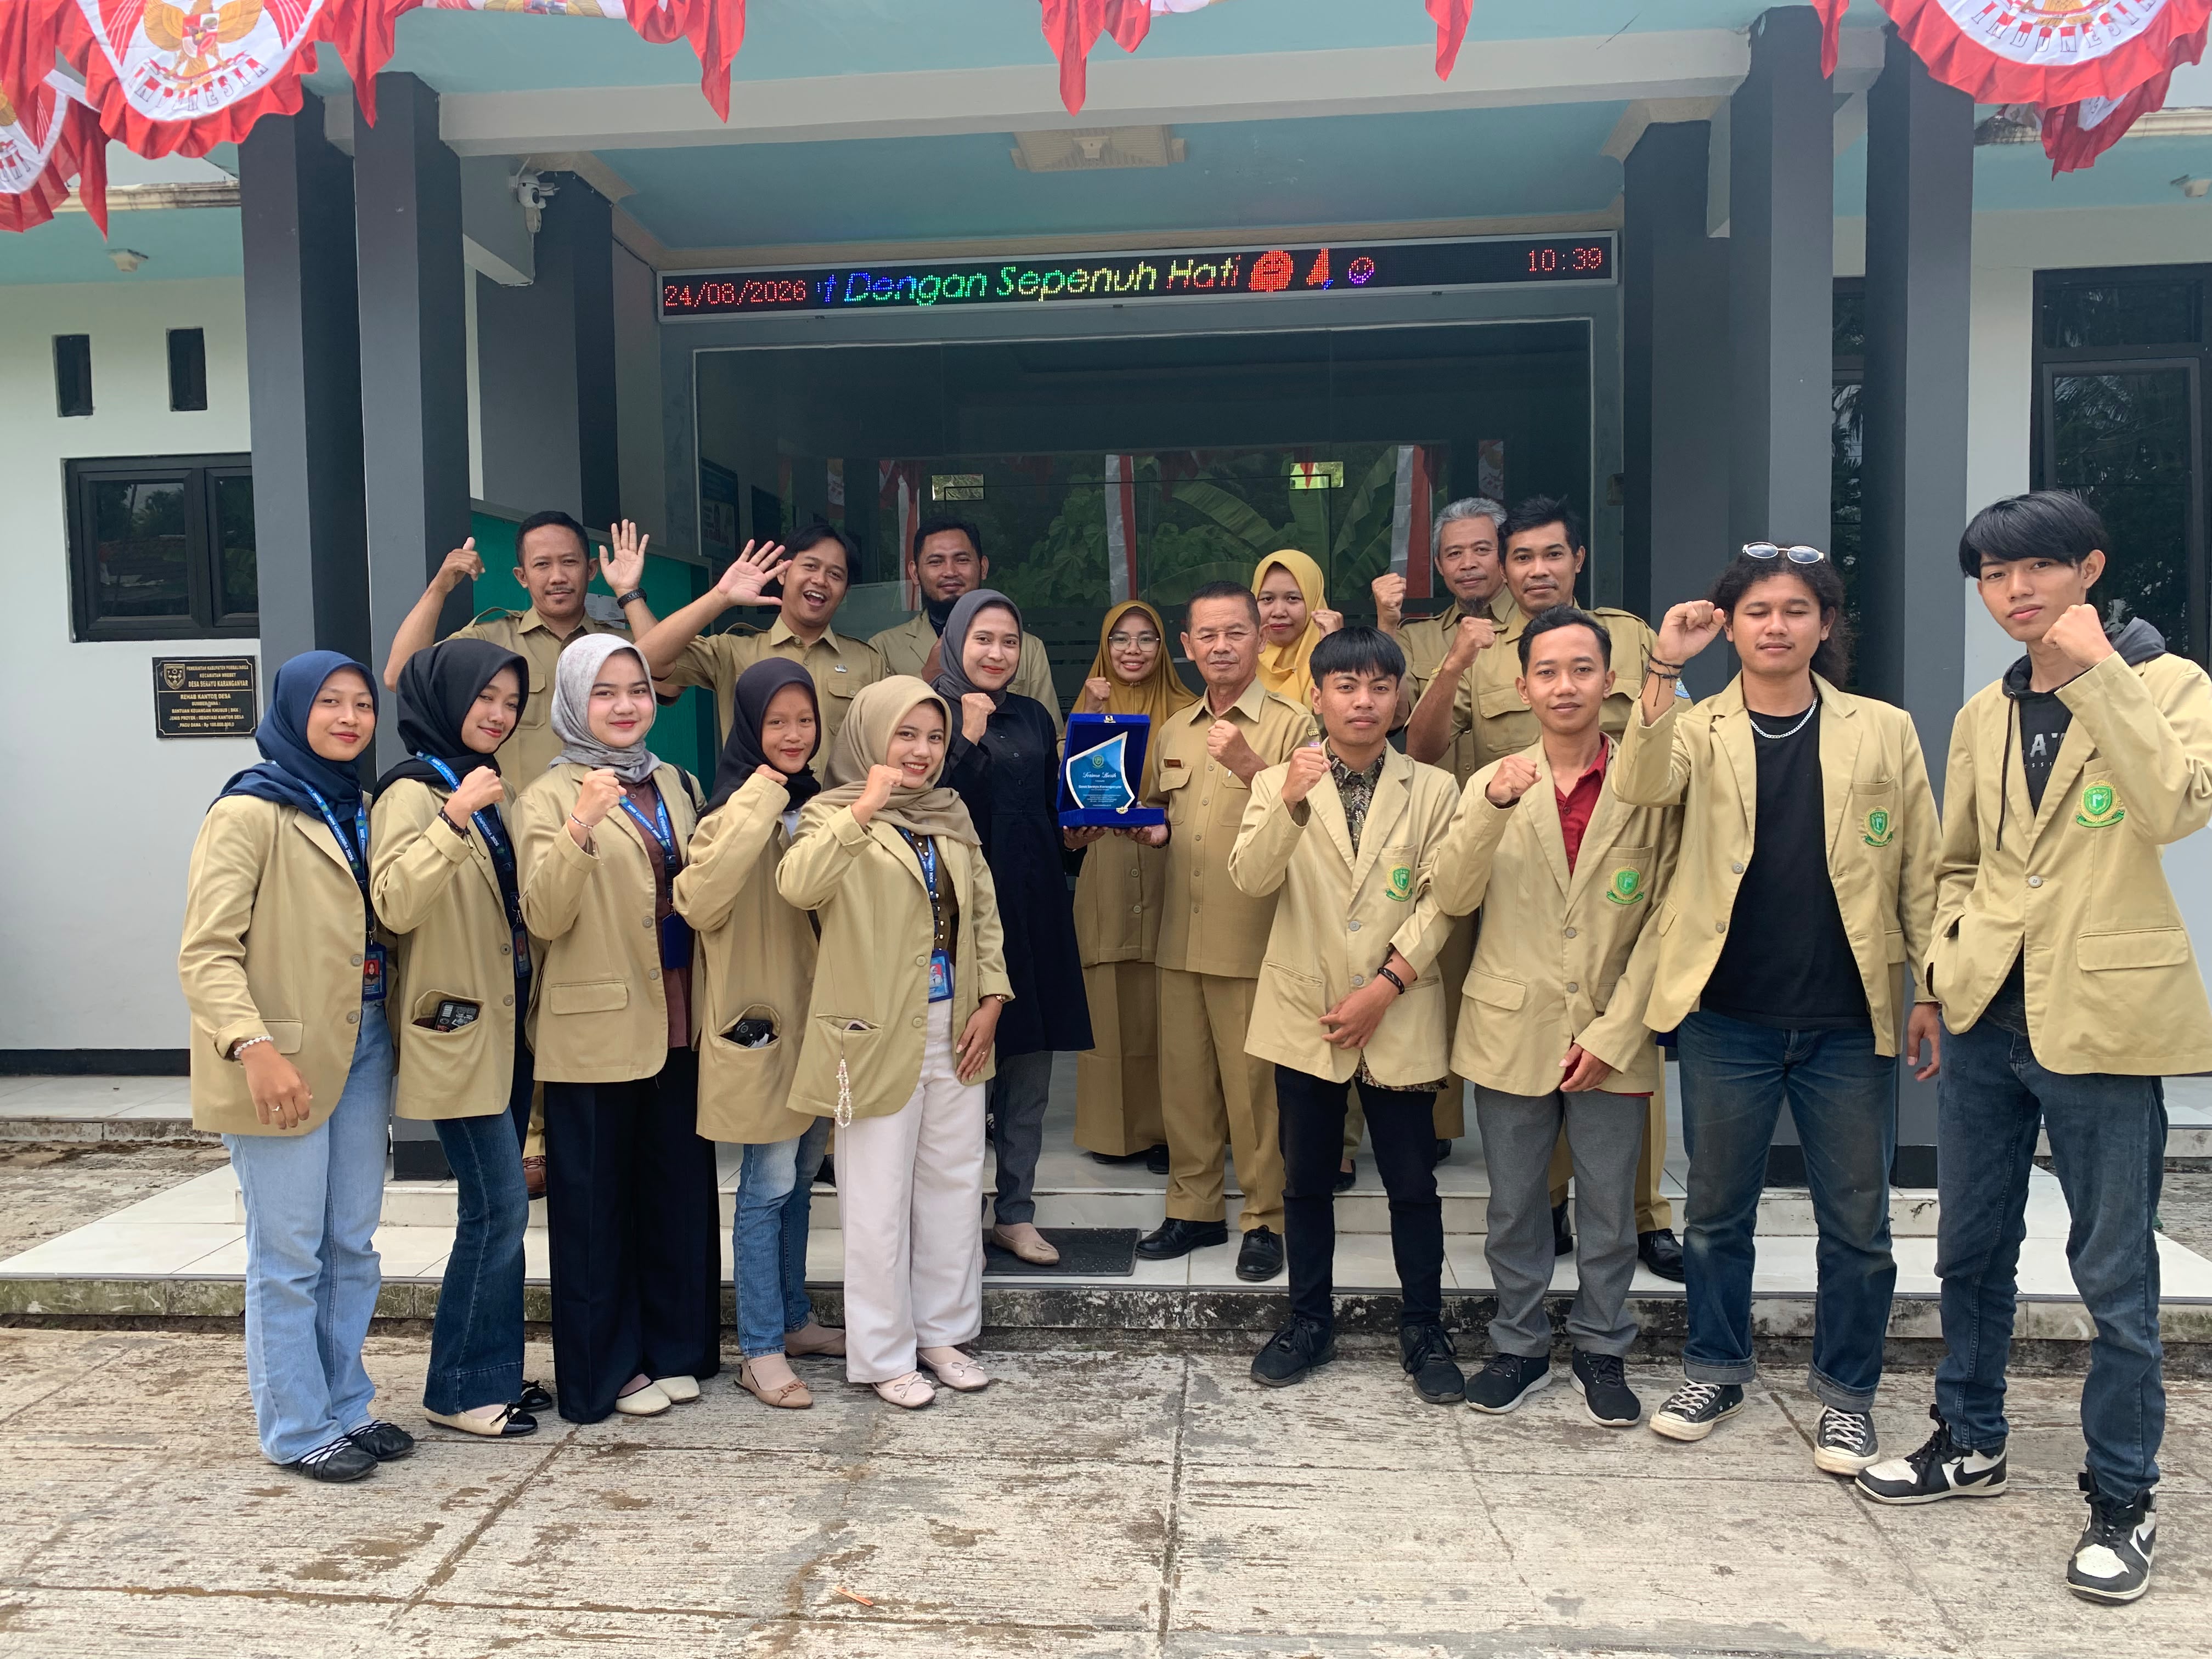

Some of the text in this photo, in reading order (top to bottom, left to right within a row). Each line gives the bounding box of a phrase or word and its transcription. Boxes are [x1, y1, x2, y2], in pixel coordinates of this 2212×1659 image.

[1529, 247, 1602, 272] 10:39
[664, 279, 806, 307] 24/08/2026
[844, 272, 988, 306] Dengan
[996, 261, 1157, 302] Sepenuh
[1166, 254, 1242, 289] Hati
[346, 848, 354, 861] 2026
